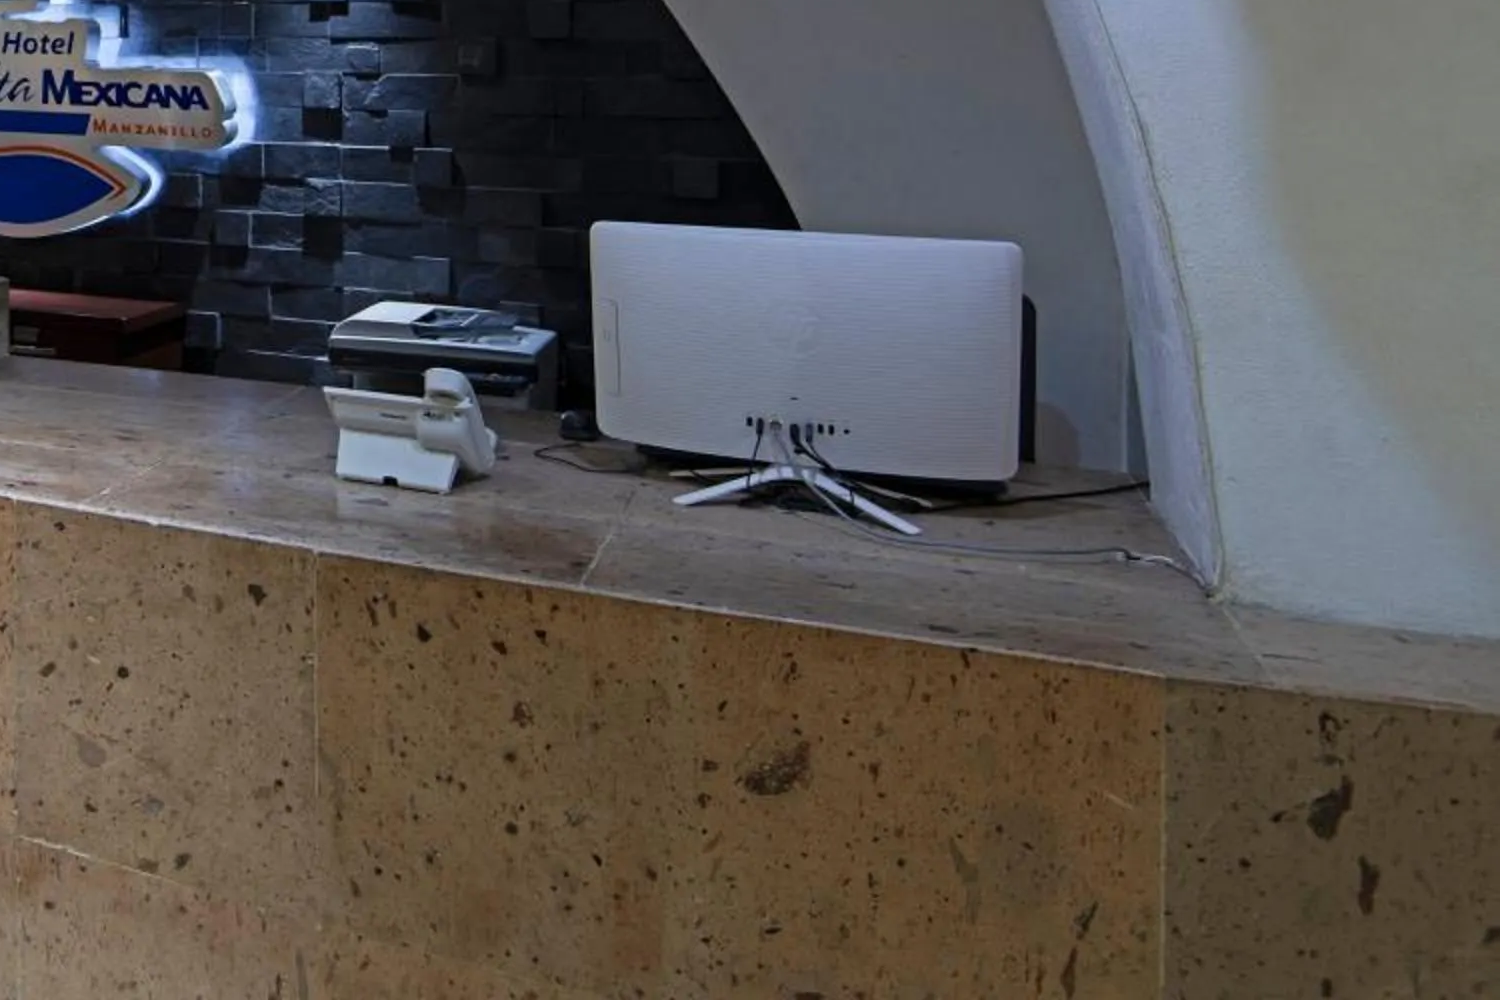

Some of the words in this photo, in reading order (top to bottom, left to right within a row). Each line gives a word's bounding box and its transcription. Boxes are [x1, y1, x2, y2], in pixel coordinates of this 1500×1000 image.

[2, 31, 75, 55] Hotel
[42, 69, 210, 111] MEXICANA
[92, 119, 214, 140] MANZANILLO
